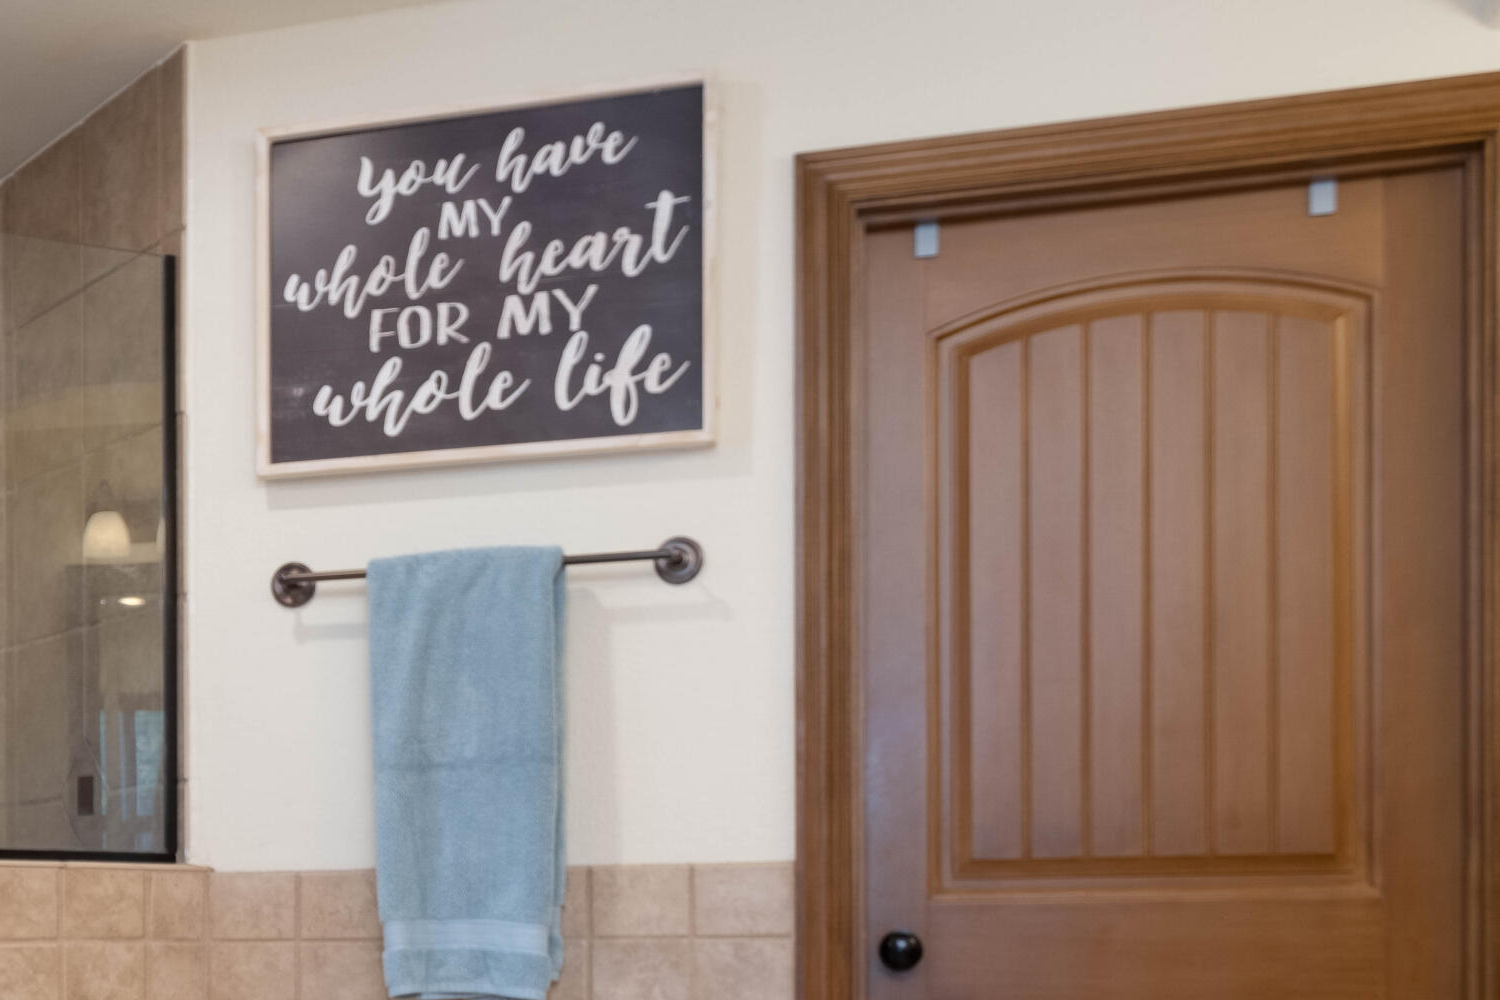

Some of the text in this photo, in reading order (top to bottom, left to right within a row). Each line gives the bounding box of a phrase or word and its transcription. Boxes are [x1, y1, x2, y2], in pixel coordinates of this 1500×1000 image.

[357, 121, 638, 225] you have
[437, 196, 511, 240] MY
[283, 190, 690, 319] whole heart
[369, 284, 598, 353] FOR MY
[313, 324, 691, 437] whole life
